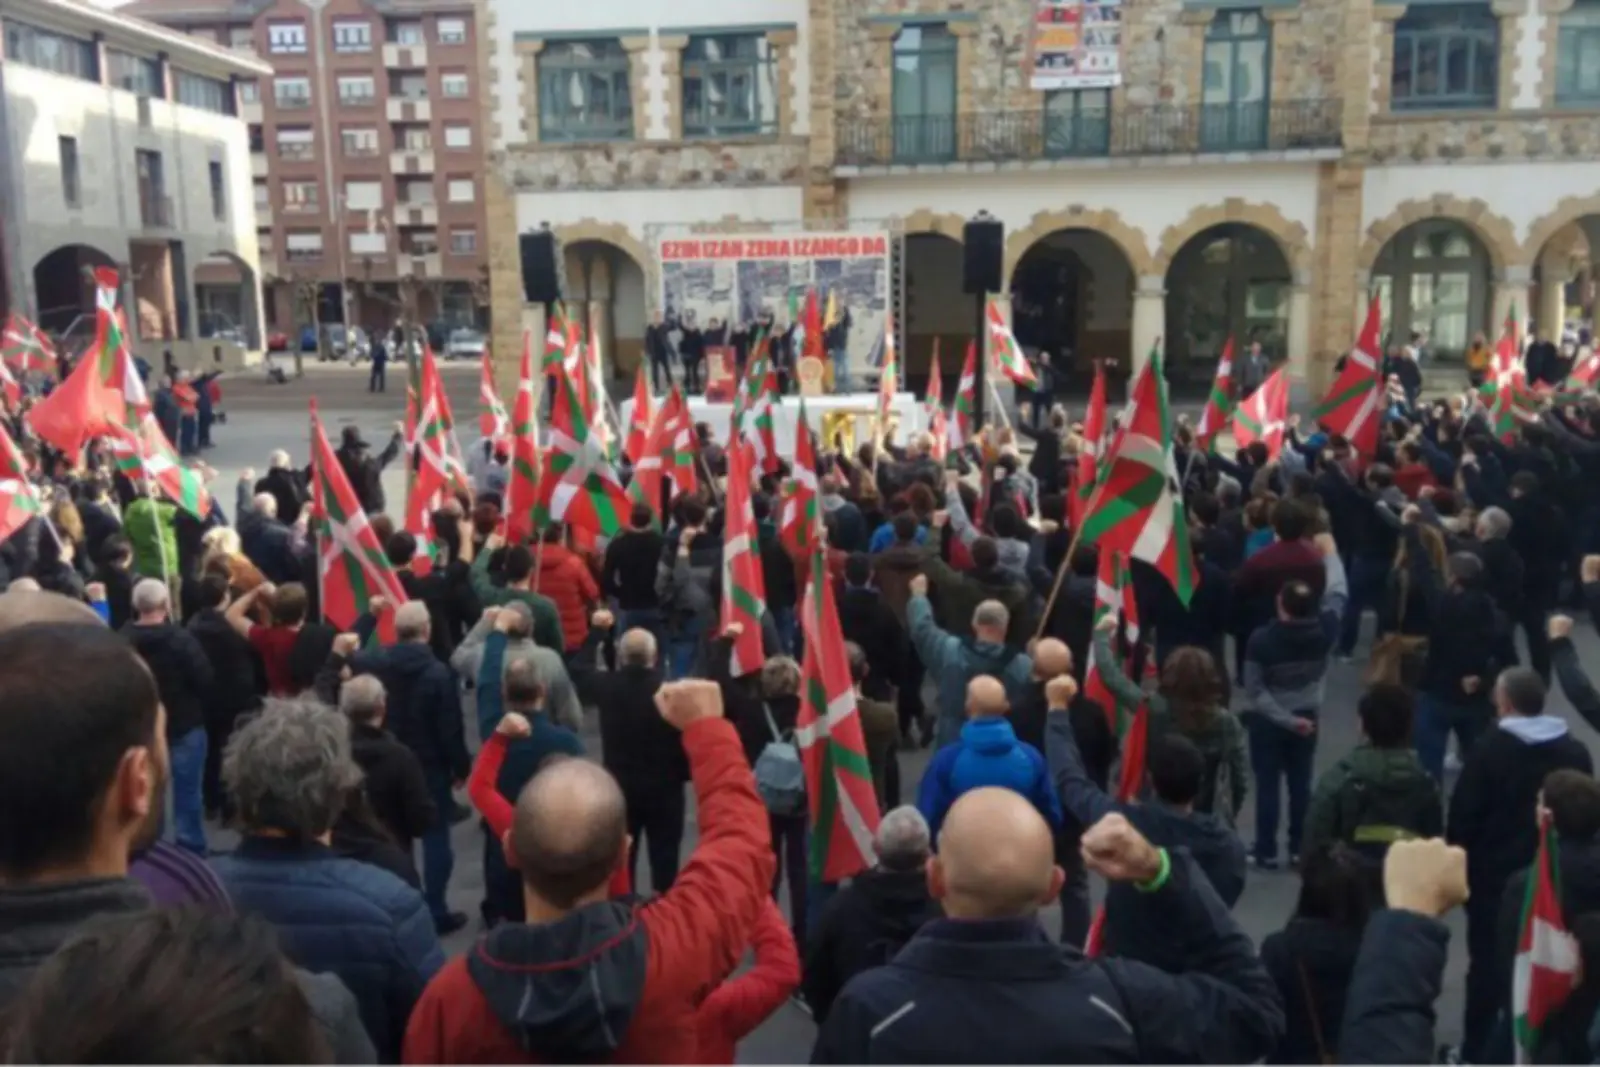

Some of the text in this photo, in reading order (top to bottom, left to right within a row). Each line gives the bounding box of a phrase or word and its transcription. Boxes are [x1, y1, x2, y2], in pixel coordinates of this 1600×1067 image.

[662, 241, 700, 259] EZIN
[702, 240, 743, 258] IZAN
[793, 237, 859, 256] IZANGO
[862, 236, 886, 255] DA
